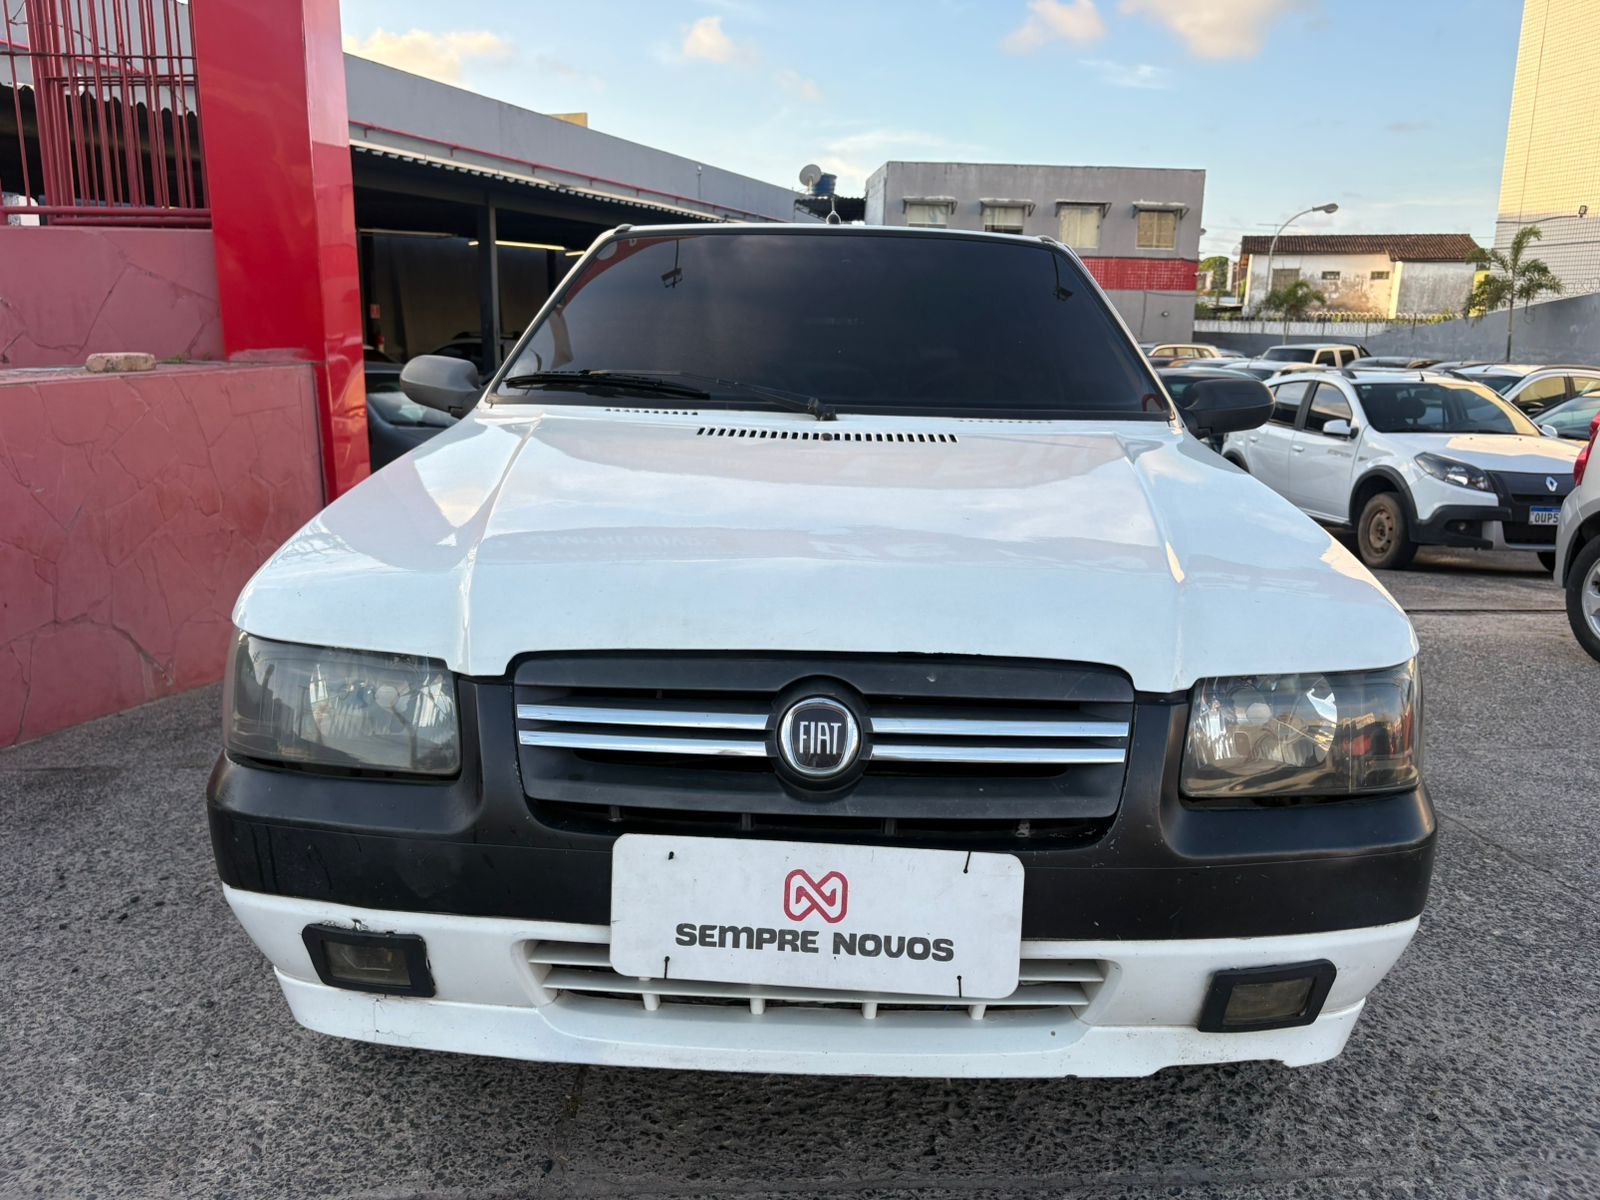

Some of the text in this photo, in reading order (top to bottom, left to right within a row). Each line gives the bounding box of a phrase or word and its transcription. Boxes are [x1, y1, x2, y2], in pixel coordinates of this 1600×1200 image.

[799, 721, 842, 755] FIAT
[675, 922, 955, 962] SEMPRE NOVOS
